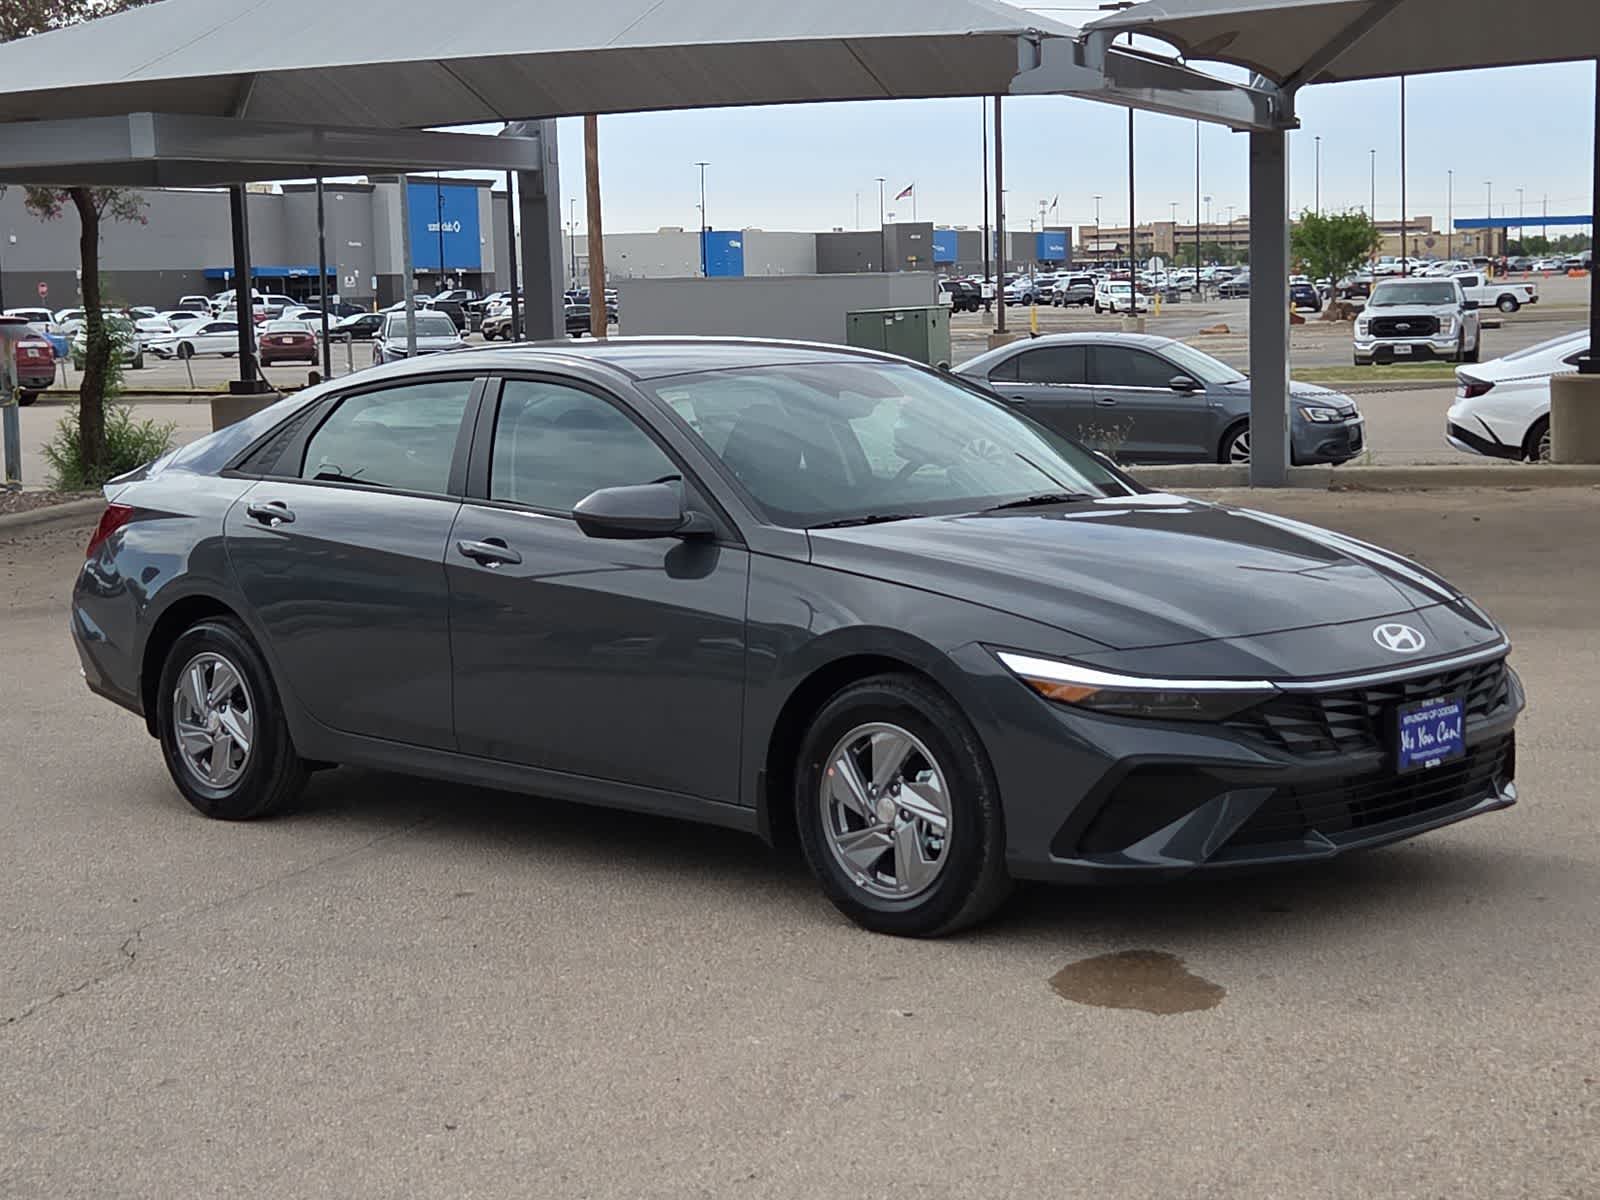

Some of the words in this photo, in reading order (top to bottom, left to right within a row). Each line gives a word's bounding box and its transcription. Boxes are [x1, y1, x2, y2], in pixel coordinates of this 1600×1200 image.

[1401, 729, 1415, 752] Yes
[1418, 724, 1435, 748] You
[1437, 717, 1461, 743] Can!
